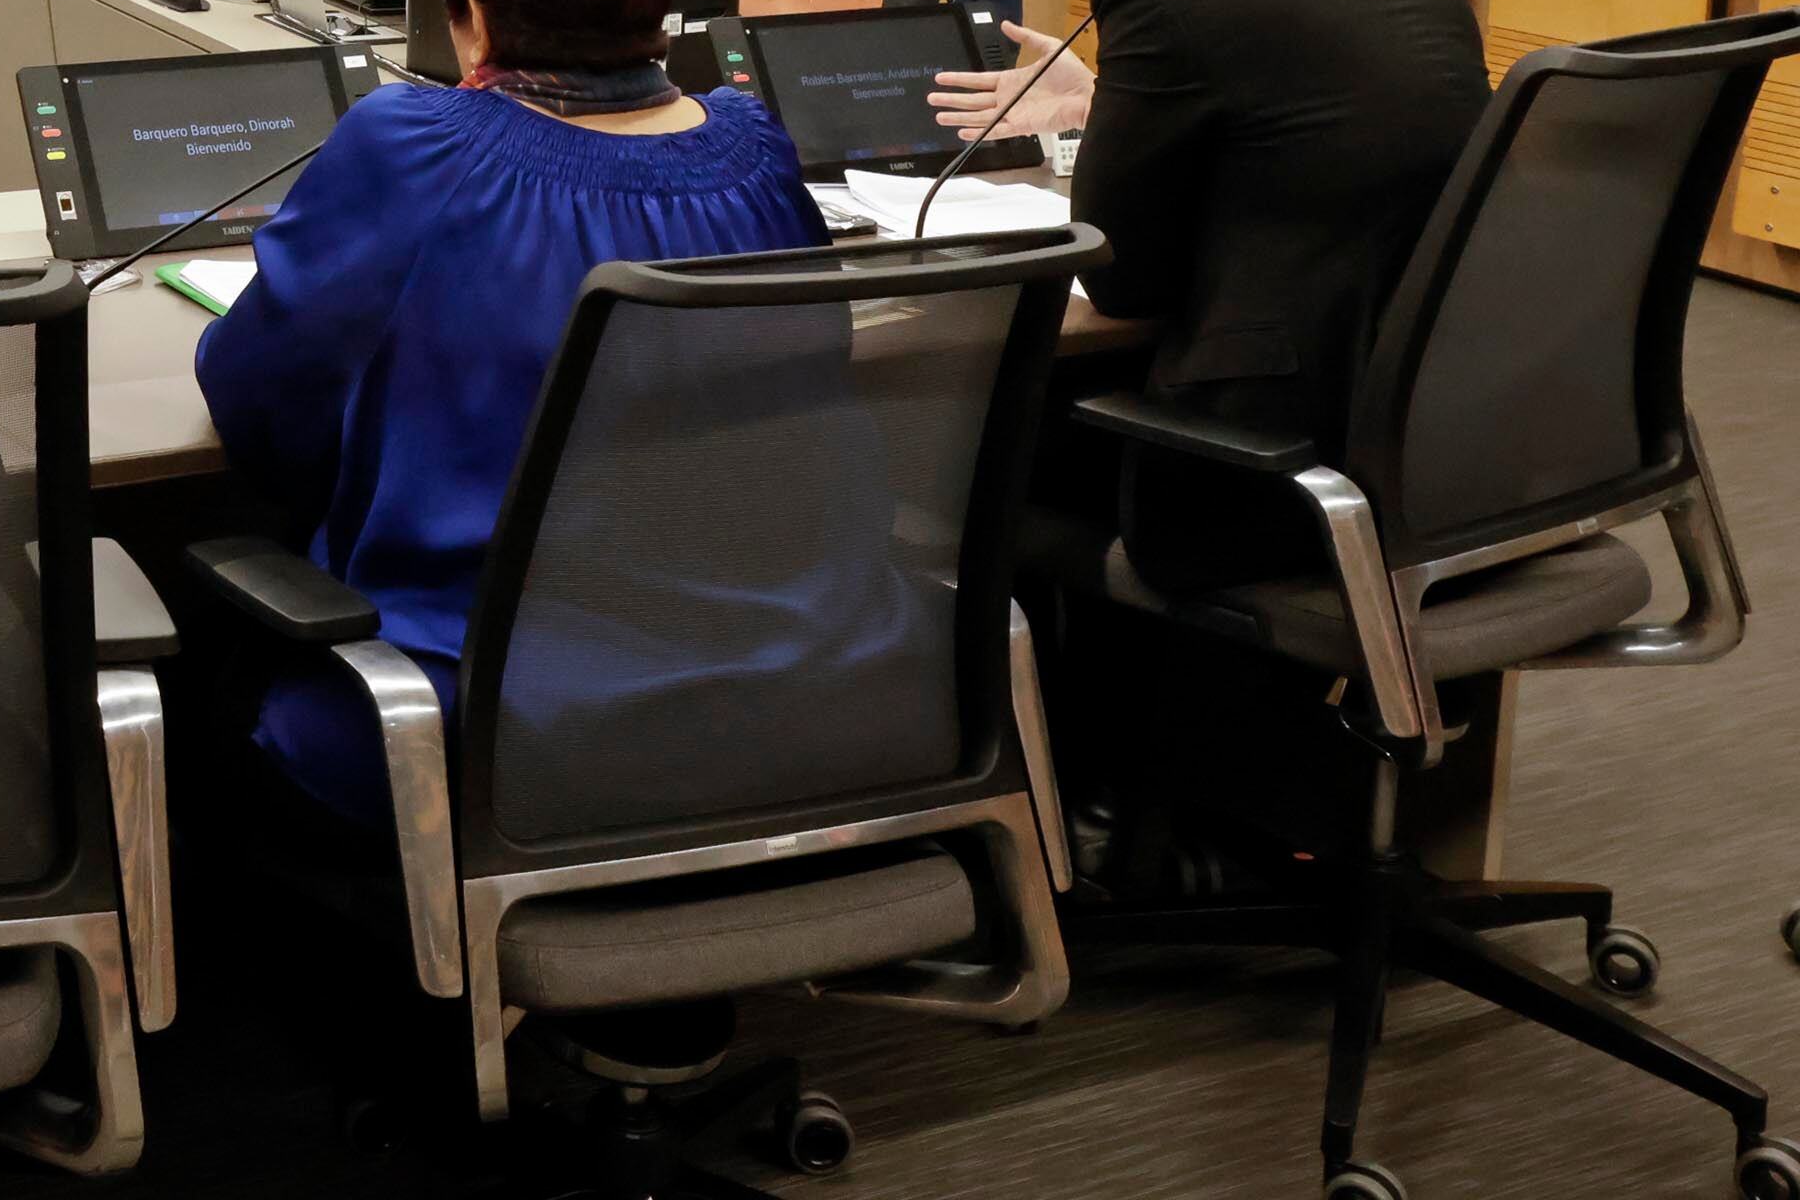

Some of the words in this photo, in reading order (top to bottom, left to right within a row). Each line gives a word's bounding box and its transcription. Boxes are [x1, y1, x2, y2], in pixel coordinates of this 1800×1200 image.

[800, 73, 835, 87] Robles
[852, 85, 905, 99] Bienvenido
[133, 127, 188, 144] Barquero
[190, 122, 248, 138] Barquero,
[248, 116, 296, 132] Dinorah
[186, 138, 252, 156] Bienvenido
